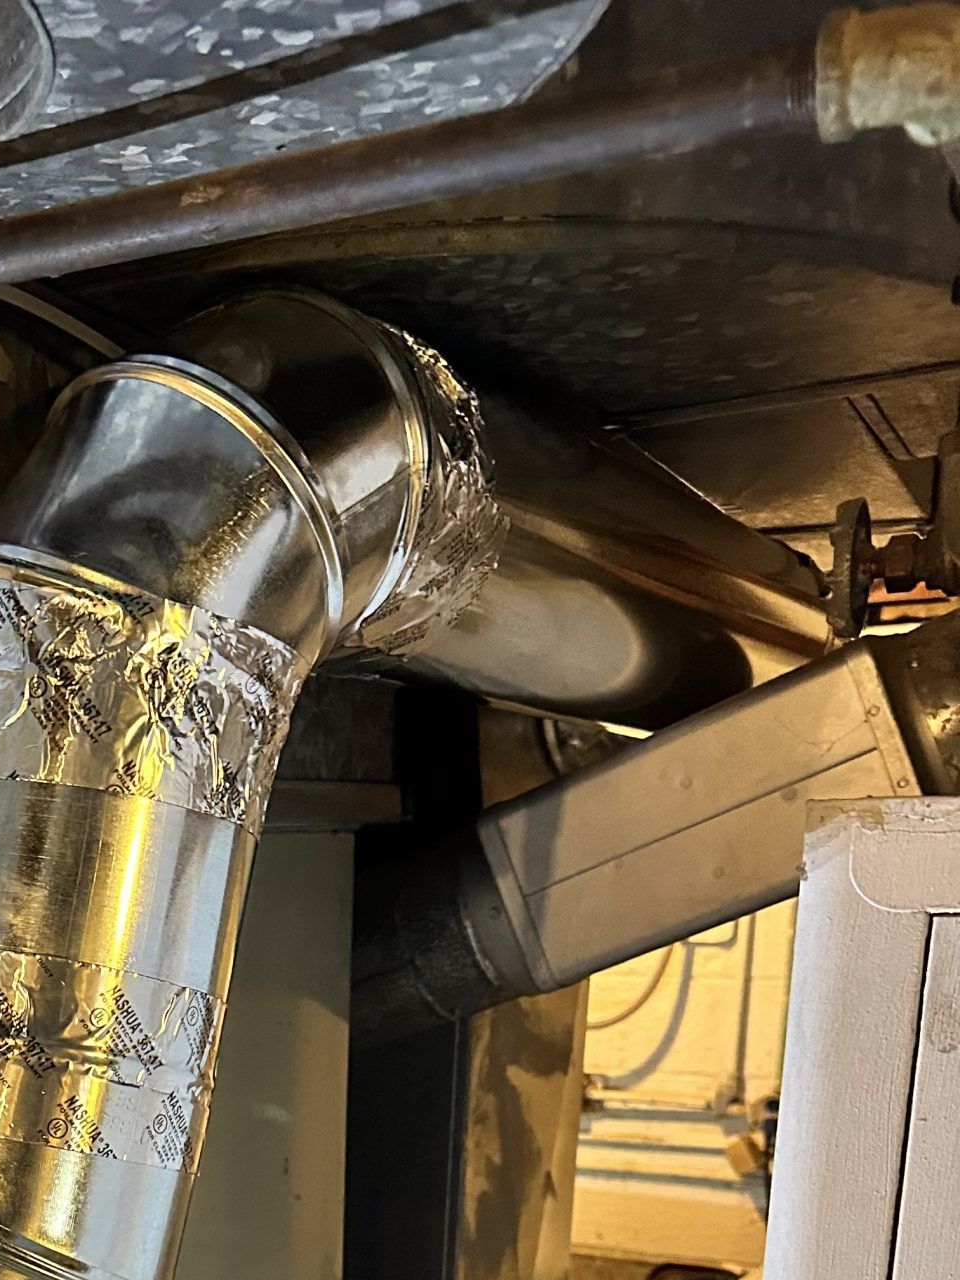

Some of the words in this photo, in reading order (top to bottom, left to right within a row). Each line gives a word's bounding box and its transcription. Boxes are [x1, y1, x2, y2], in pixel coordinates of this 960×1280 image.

[38, 958, 54, 978] DUCT
[112, 1027, 131, 1054] LISTED
[136, 1034, 165, 1071] 367-17
[152, 1141, 165, 1164] CLASS
